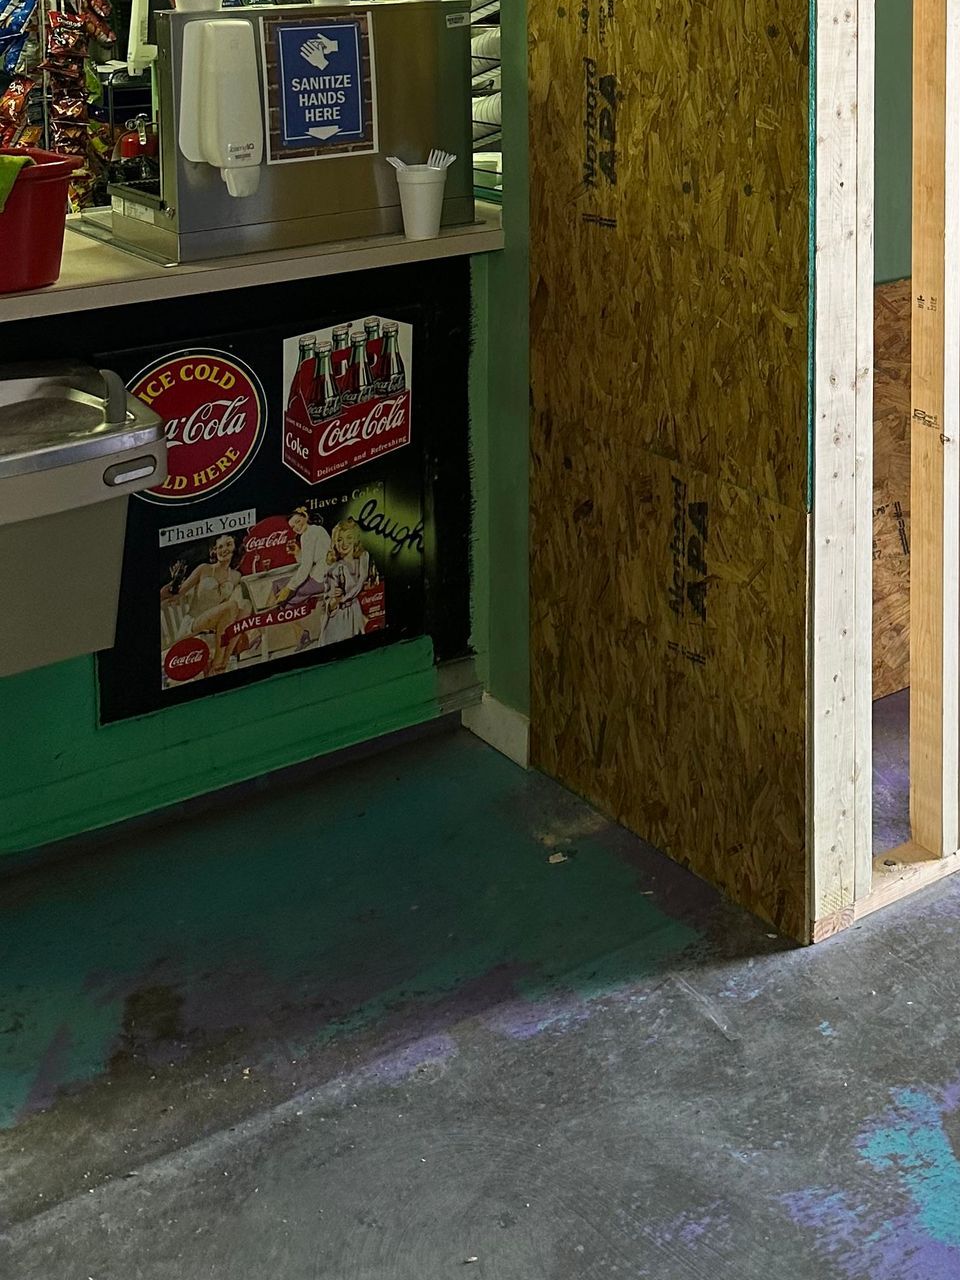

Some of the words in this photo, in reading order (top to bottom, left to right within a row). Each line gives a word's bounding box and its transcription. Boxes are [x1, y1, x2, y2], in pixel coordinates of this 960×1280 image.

[291, 74, 352, 91] SANITIZE
[299, 91, 346, 107] HANDS
[305, 106, 341, 122] HERE
[583, 57, 597, 187] Norbord
[599, 75, 617, 185] APA
[138, 371, 175, 405] ICE
[180, 364, 236, 390] COLD
[165, 395, 250, 448] a-Cola
[318, 394, 408, 457] Coca-Cola
[286, 431, 309, 460] Coke
[317, 459, 348, 477] Delicious
[353, 451, 367, 462] and
[370, 435, 407, 455] Refreshing
[162, 475, 187, 490] LD
[193, 447, 240, 487] HERE
[165, 521, 214, 543] Thank
[218, 512, 251, 531] You!
[245, 529, 289, 552] Coca-Cola
[349, 499, 425, 557] laugh
[669, 475, 681, 617] Norbord
[687, 502, 708, 624] APA
[233, 616, 262, 634] HAVE
[266, 613, 273, 624] A
[277, 605, 308, 622] COKE
[168, 650, 204, 669] Coca-Cola
